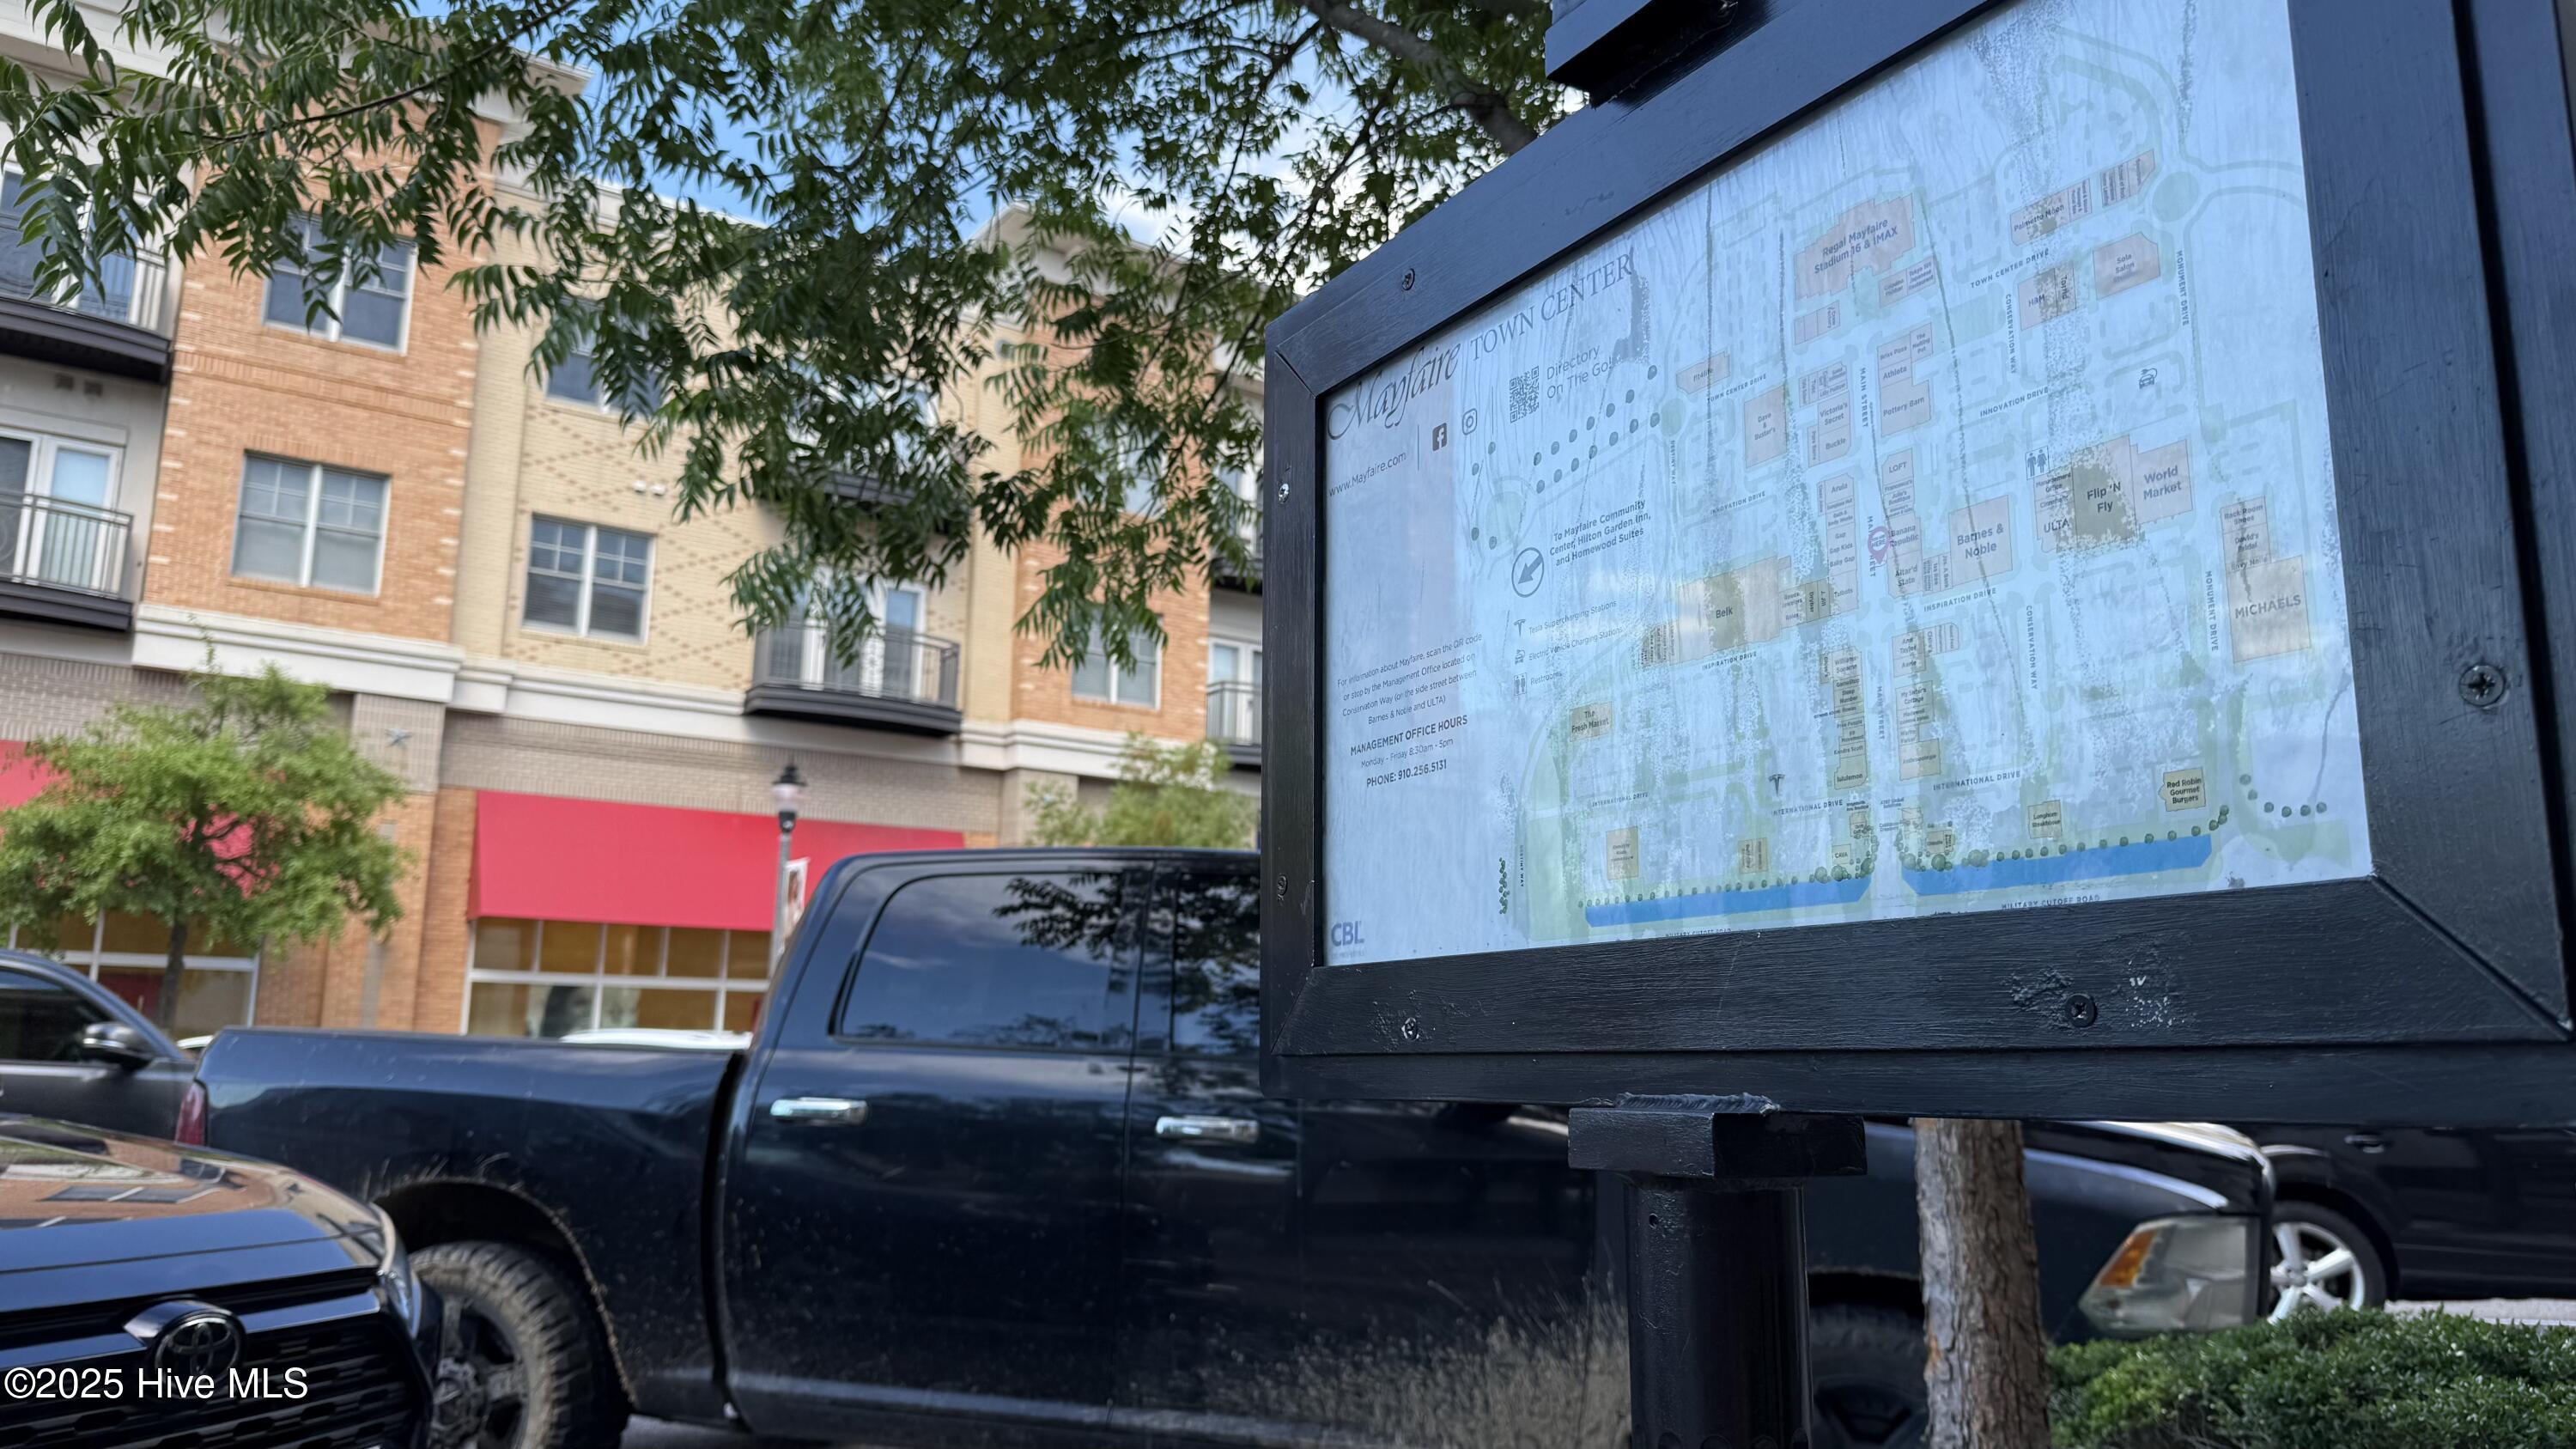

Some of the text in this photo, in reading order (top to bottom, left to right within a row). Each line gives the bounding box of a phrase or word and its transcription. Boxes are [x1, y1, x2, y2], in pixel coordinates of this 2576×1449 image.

[1814, 251, 1850, 275] Stadium
[1874, 225, 1899, 245] IMAX
[1822, 219, 1888, 258] Regal Mayfaire
[1970, 247, 2050, 289] TOWN CENTER DRIVE
[2175, 250, 2190, 326] MONUMENT DRIVE
[2005, 294, 2015, 356] CONSERVATION
[1327, 254, 1633, 440] Mayfaire TOWN CENTER
[1546, 345, 1601, 381] Directory
[1546, 356, 1613, 399] On The Go!
[1707, 372, 1767, 405] TOWN CENTER DRIVE
[1883, 404, 1908, 417] Pottery
[1980, 386, 2050, 418] INNOVATION DRIVE
[1328, 452, 1407, 497] www.Mayfaire.com
[1889, 461, 1907, 473] LOFT
[2143, 465, 2178, 484] World
[1748, 490, 1767, 503] DRIVE
[2087, 487, 2106, 501] Flip
[2142, 482, 2183, 501] Market
[2097, 500, 2114, 514] Fly
[1553, 499, 1646, 542] To Mayfaire Community
[1957, 522, 2005, 545] Barnes &
[2044, 518, 2069, 533] ULTA
[1549, 512, 1652, 557] Center, Hilton Garden Inn,
[1555, 527, 1645, 567] and Homewood Suites
[1965, 541, 1997, 559] Noble
[1924, 586, 1997, 612] INSPIRATION DRIVE
[2205, 570, 2216, 621] MONUMENT
[2234, 594, 2303, 620] MICHAELS
[1528, 600, 1619, 636] Tesla Supercharging Stations
[1716, 606, 1734, 619] Belk
[1571, 634, 1599, 648] Charging
[1599, 624, 1624, 640] Stations
[2026, 606, 2036, 667] CONSERVATION
[1337, 679, 1347, 689] For
[1349, 668, 1379, 685] information
[1380, 662, 1399, 674] about
[1426, 647, 1442, 658] scan
[1443, 643, 1453, 654] the
[1453, 636, 1464, 649] QR
[1465, 632, 1483, 645] code
[1702, 650, 1758, 671] INSPIRATION DRIVE
[1352, 689, 1364, 701] stop
[1364, 686, 1372, 697] by
[1372, 682, 1382, 692] the
[1382, 671, 1420, 688] Management
[1421, 664, 1441, 677] Office
[1442, 654, 1465, 670] located
[1466, 653, 1476, 662] on
[1379, 694, 1393, 707] Way
[1394, 691, 1404, 703] (on
[1404, 689, 1415, 698] the
[1415, 683, 1429, 695] side
[1429, 678, 1448, 691] street
[1448, 669, 1477, 685] between
[1530, 671, 1564, 686] Restrooms
[1368, 693, 1447, 726] Barnes & Noble and ULTA)
[1584, 709, 1595, 720] The
[1350, 714, 1469, 756] MANAGEMENT OFFICE HOURS
[1571, 717, 1610, 734] Fresh Market
[1361, 755, 1385, 769] Monday
[1389, 749, 1409, 763] Friday
[1408, 742, 1435, 757] 8:30am
[1438, 737, 1455, 750] 5pm
[1366, 758, 1447, 788] PHONE: 910.256.5131
[1933, 770, 2021, 792] INTERNATIONAL DRIVE
[2166, 776, 2202, 790] Red Robin
[1591, 791, 1649, 807] INTERNATIONAL DRIVE
[2170, 785, 2200, 797] Gourmet
[2172, 795, 2200, 806] Burgers
[1771, 800, 1822, 816] INTERNATIONAL
[1823, 799, 1844, 810] DRIVE
[1834, 850, 1849, 860] CAVA
[2041, 897, 2074, 907] CUTOFF
[2076, 894, 2101, 904] ROAD
[1331, 920, 1365, 947] CBL
